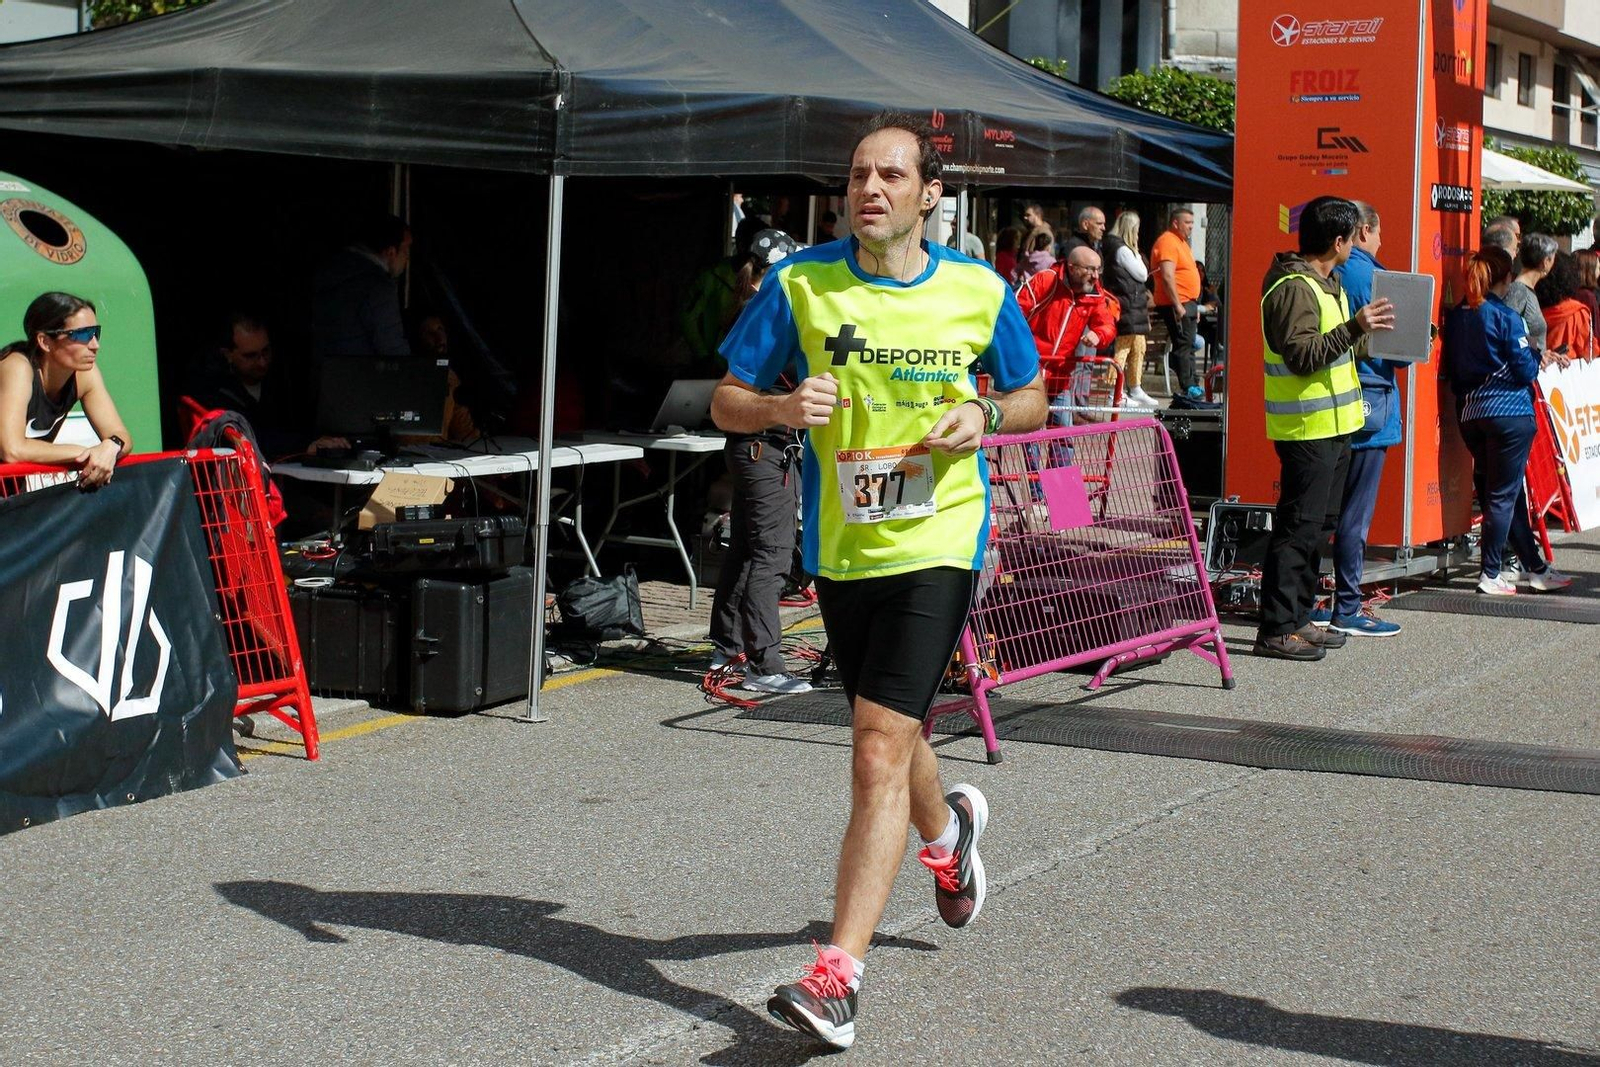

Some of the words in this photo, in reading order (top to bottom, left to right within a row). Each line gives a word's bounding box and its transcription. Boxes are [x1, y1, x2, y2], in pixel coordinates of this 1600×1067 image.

[1301, 37, 1338, 46] ESTACIONES
[1348, 35, 1377, 44] SERVICIO
[1290, 68, 1361, 94] FROIZ
[1338, 94, 1361, 102] servicio
[984, 129, 1016, 142] MYLAPS
[1277, 154, 1298, 162] Grupo
[1299, 153, 1320, 161] Godoy
[1321, 152, 1349, 160] Maceira
[1438, 184, 1465, 202] RODOSA
[46, 242, 84, 262] VIDRIO
[890, 366, 959, 383] Atlántico
[860, 463, 874, 472] SR.
[878, 461, 898, 470] LOBO
[854, 471, 905, 508] 377
